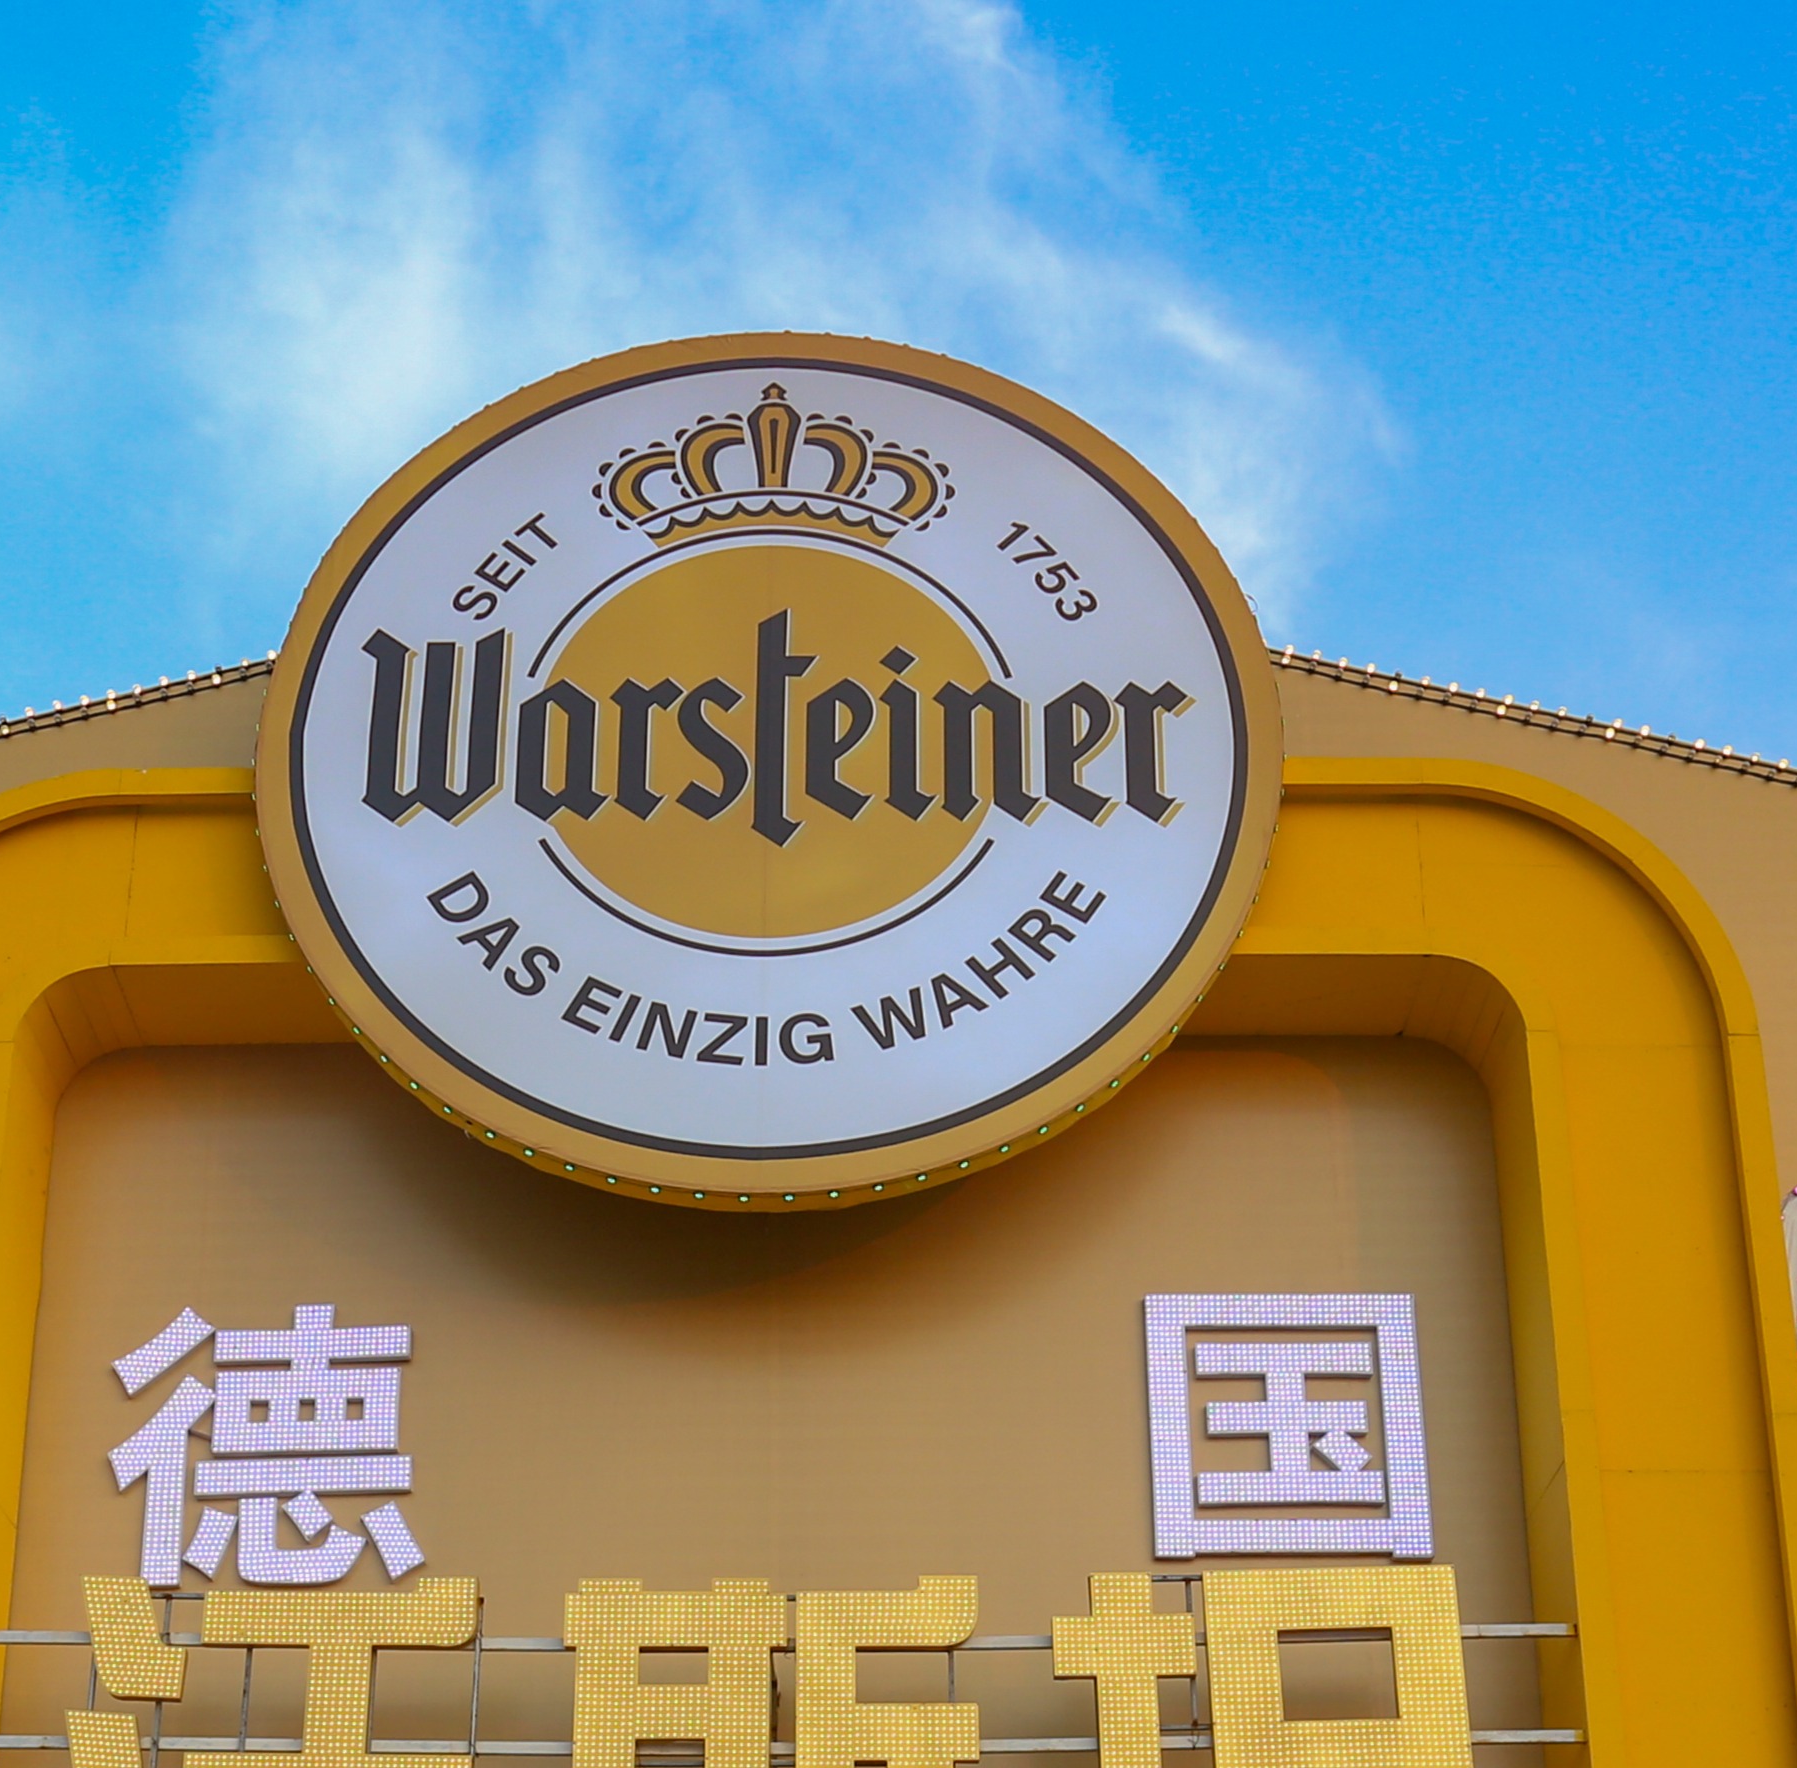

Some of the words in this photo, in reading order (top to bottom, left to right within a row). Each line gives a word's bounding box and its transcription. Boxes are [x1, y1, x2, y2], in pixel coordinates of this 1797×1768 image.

[452, 512, 560, 621] SEIT
[995, 519, 1099, 623] 1753
[361, 608, 1197, 847] Warsteiner
[426, 870, 561, 996] DAS
[560, 974, 835, 1066] EINZIG
[849, 870, 1107, 1050] WAHRE
